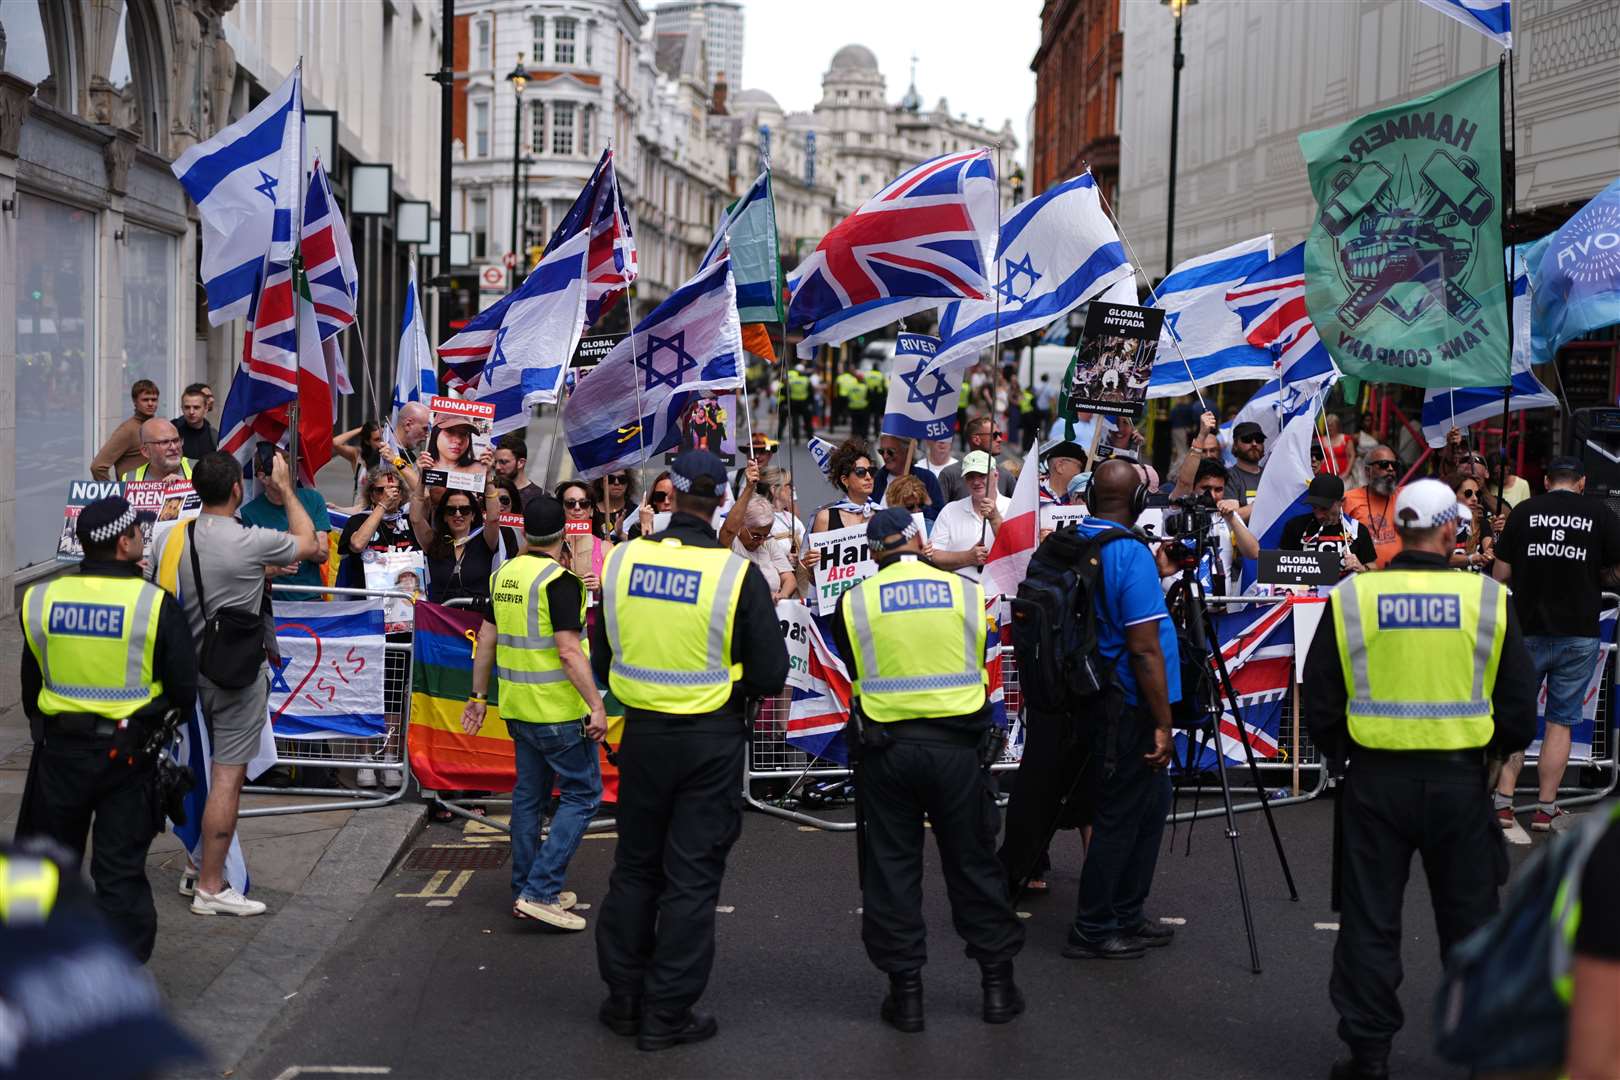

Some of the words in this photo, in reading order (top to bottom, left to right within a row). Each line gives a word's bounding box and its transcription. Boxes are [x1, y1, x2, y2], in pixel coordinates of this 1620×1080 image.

[1108, 308, 1144, 319] GLOBAL
[1104, 317, 1145, 328] INTIFADA
[581, 339, 615, 349] GLOBAL
[900, 339, 937, 353] RIVER
[579, 348, 613, 357] INTIFAD
[433, 399, 492, 414] KIDNAPPED
[926, 422, 949, 437] SEA
[71, 483, 121, 499] NOVA
[127, 483, 166, 491] MANCHEST
[127, 491, 164, 505] AREN
[1529, 513, 1593, 532] ENOUGH
[1551, 529, 1565, 541] IS
[1527, 543, 1587, 560] ENOUGH
[1280, 555, 1318, 565] GLOBAL
[826, 563, 855, 582] Are
[1276, 565, 1321, 574] INTIFADA
[502, 579, 520, 589] LEGAL
[630, 568, 698, 599] POLICE
[494, 592, 523, 604] OBSERVER
[882, 583, 950, 608] POLICE
[1381, 598, 1457, 623] POLICE
[52, 606, 120, 632] POLICE
